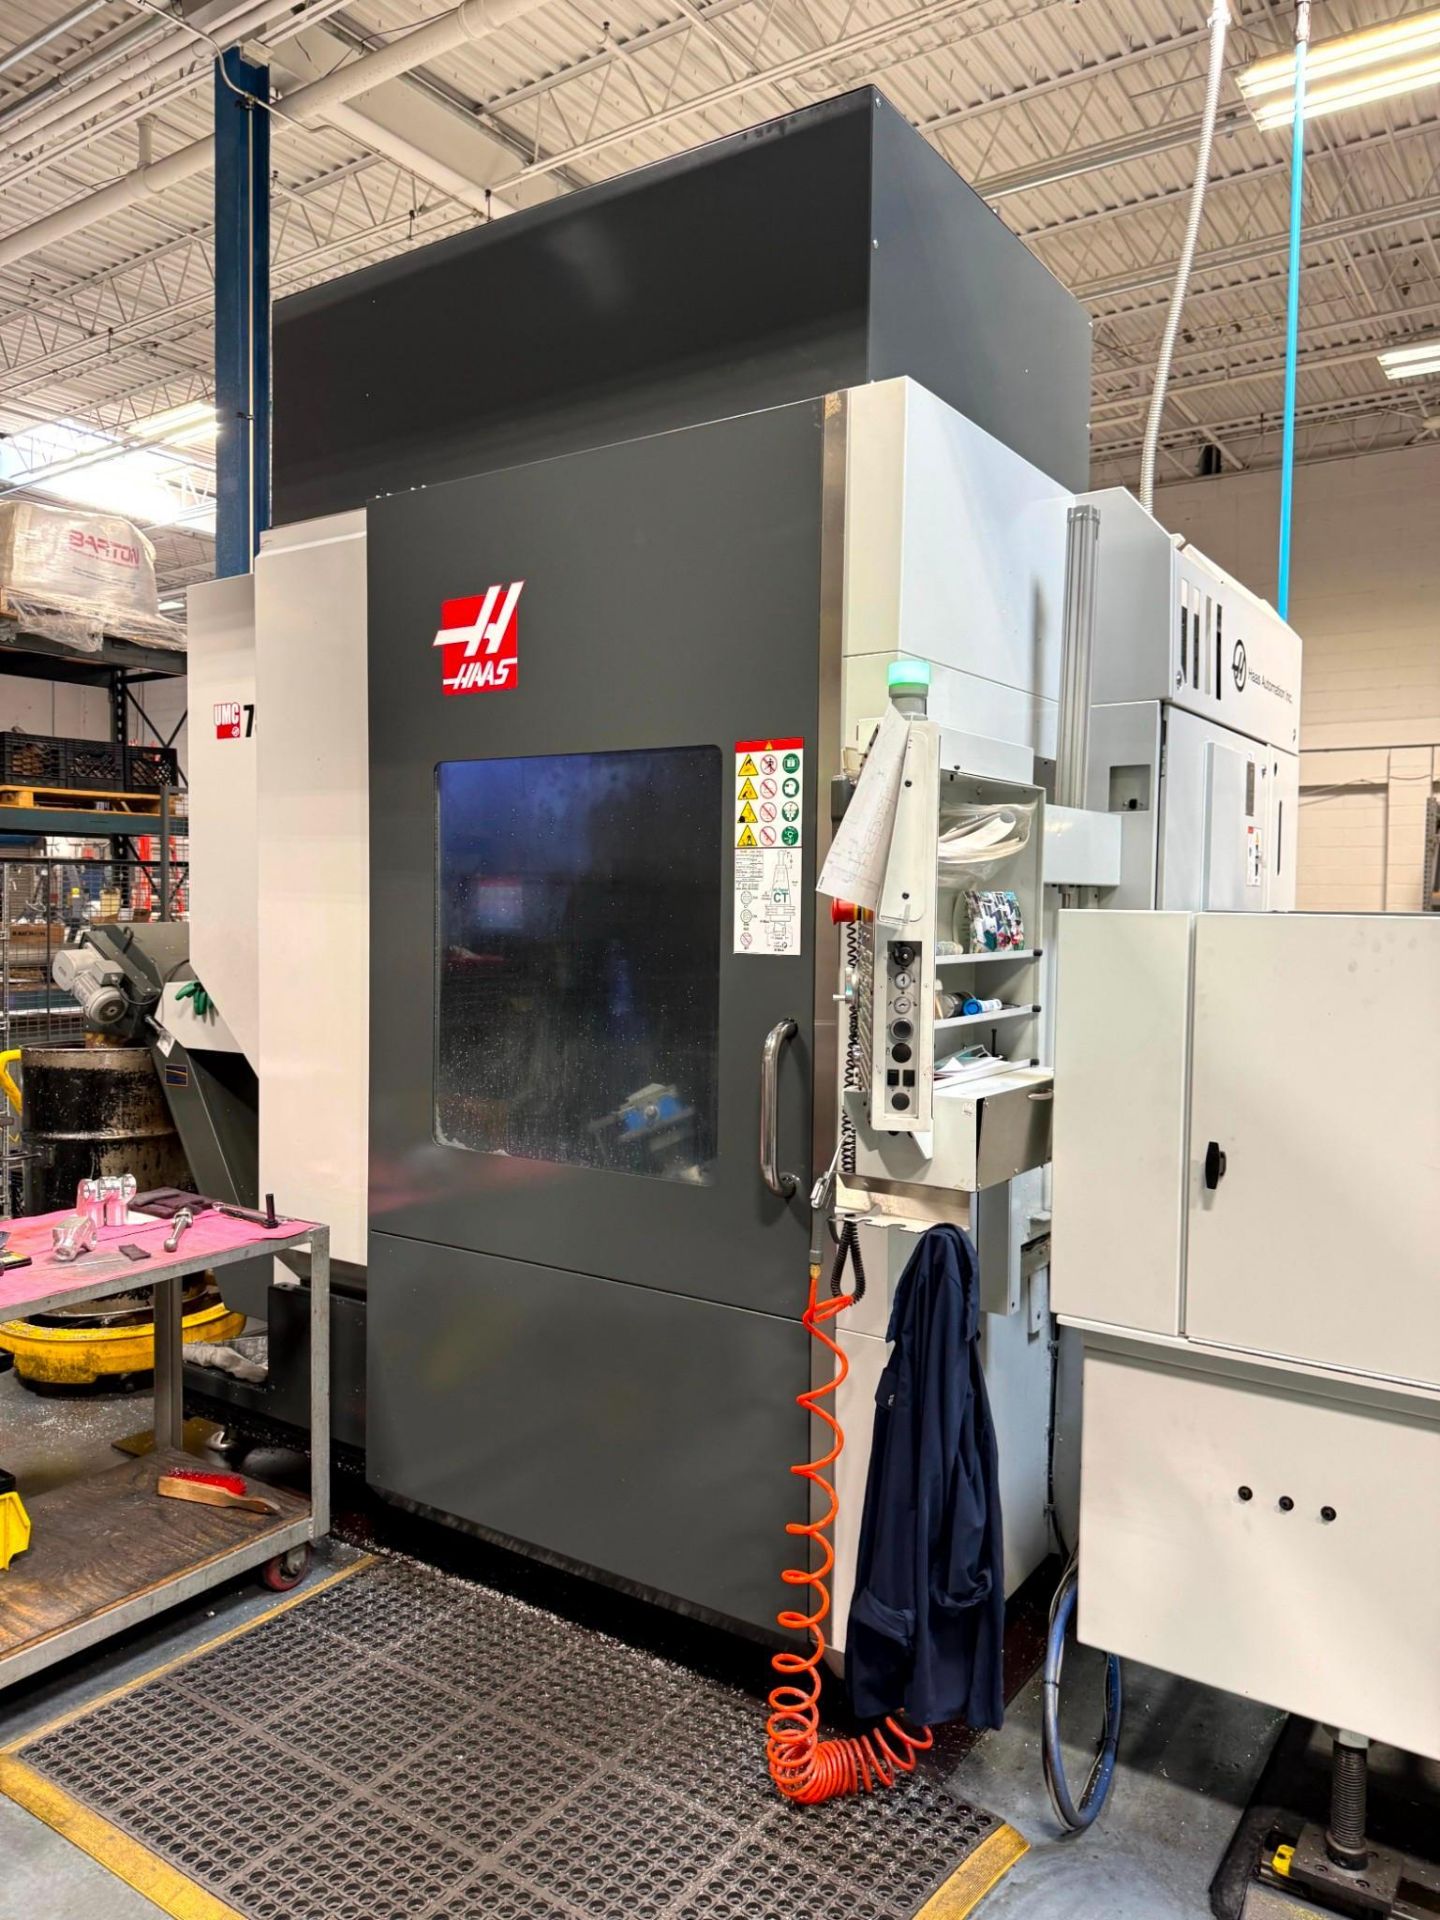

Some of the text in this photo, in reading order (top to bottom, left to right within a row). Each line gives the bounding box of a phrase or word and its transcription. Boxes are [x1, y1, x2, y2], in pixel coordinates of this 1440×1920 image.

[69, 530, 140, 565] BARTON
[443, 657, 518, 690] HAAS
[214, 702, 240, 726] UMC
[773, 892, 789, 903] CT
